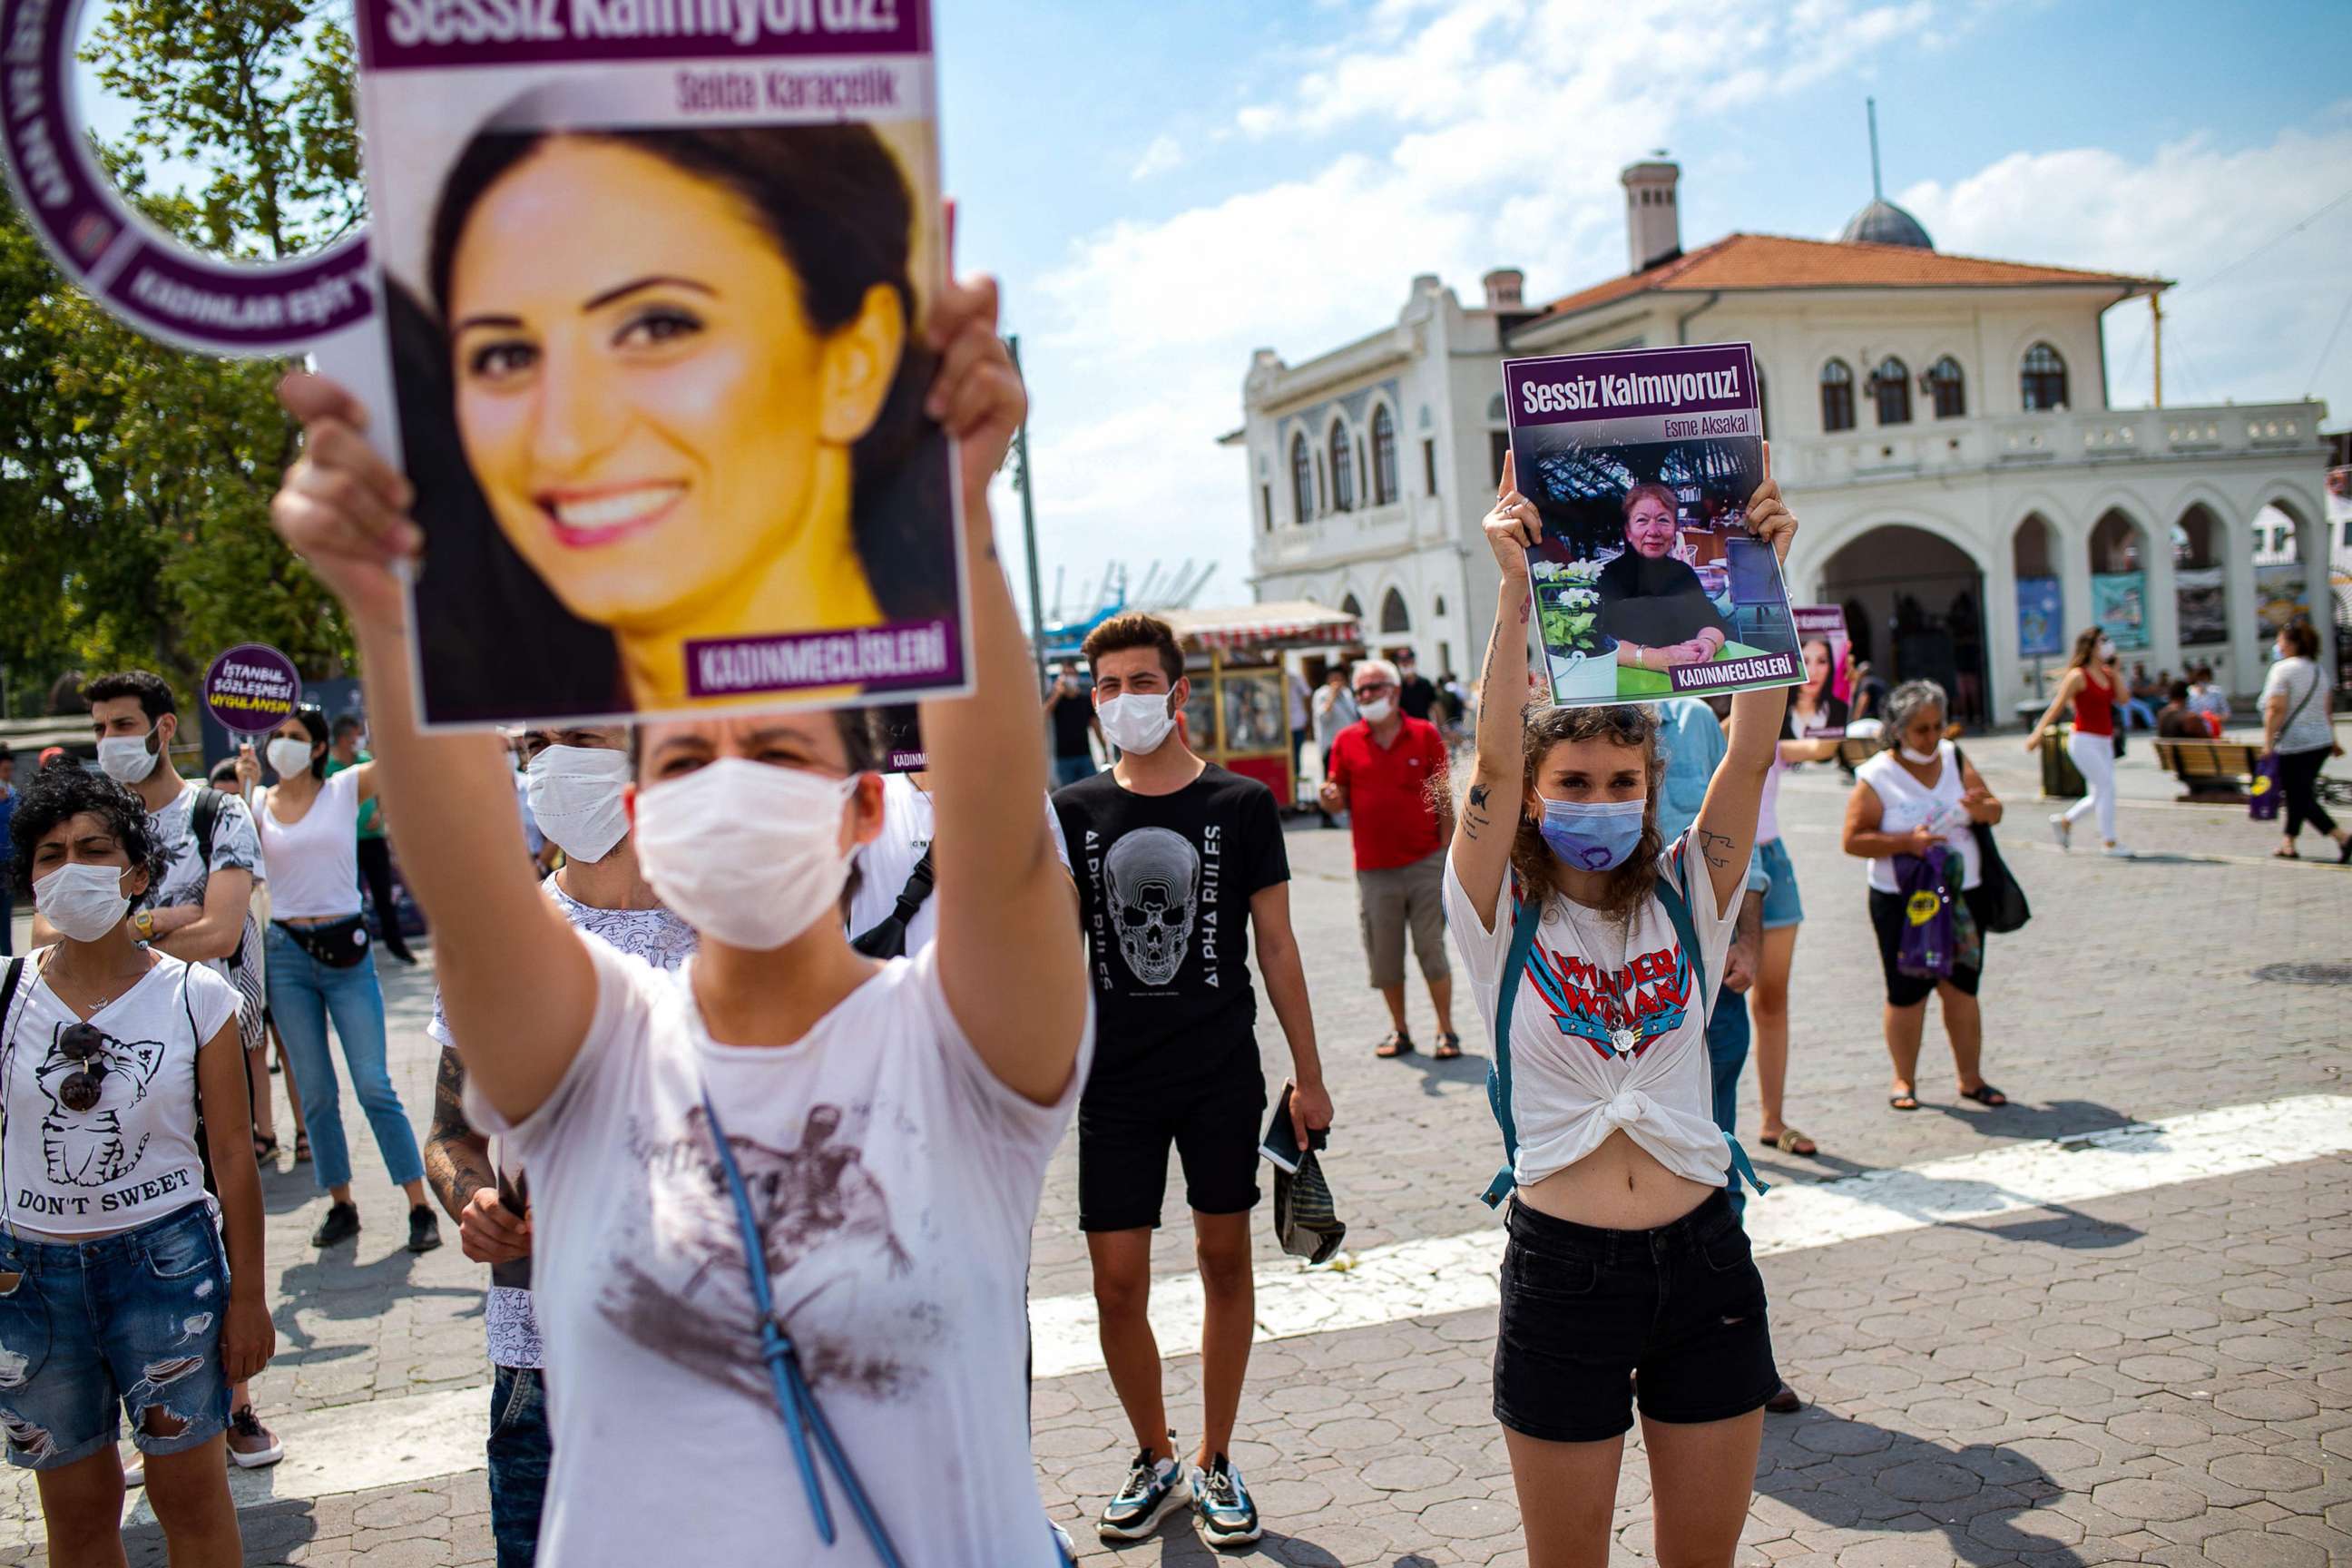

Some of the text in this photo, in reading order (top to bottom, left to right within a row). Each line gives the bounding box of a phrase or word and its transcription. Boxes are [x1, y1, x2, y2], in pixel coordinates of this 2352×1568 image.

[1522, 365, 1741, 414] Sessiz Kalmıyoruz!
[1664, 414, 1749, 438] Esme Aksakal
[223, 660, 284, 682] İSTANBUL
[1677, 653, 1793, 687] KADINMECLİSLERİ
[1202, 825, 1220, 988] ALPHA RULES
[17, 1168, 191, 1215] DON'T SWEET
